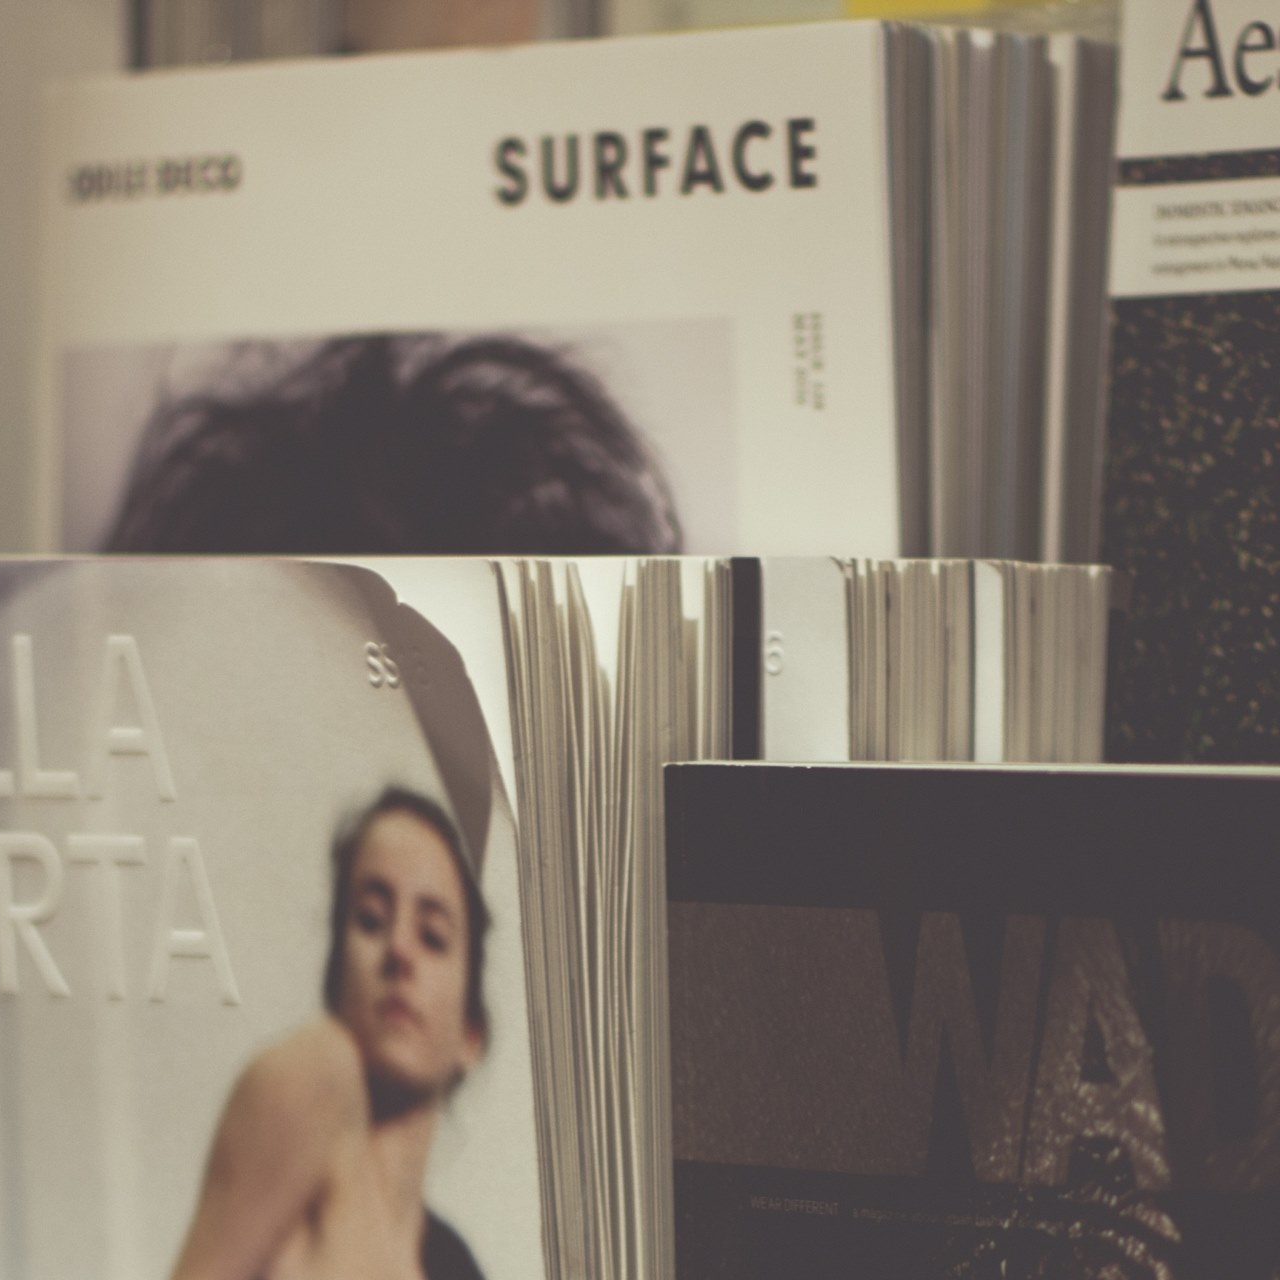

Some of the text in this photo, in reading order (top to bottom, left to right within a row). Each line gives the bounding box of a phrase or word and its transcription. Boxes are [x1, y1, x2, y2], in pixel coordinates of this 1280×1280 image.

[494, 117, 819, 207] SURFACE
[750, 1196, 781, 1211] WEAR
[783, 1199, 840, 1216] DIFFERENT
